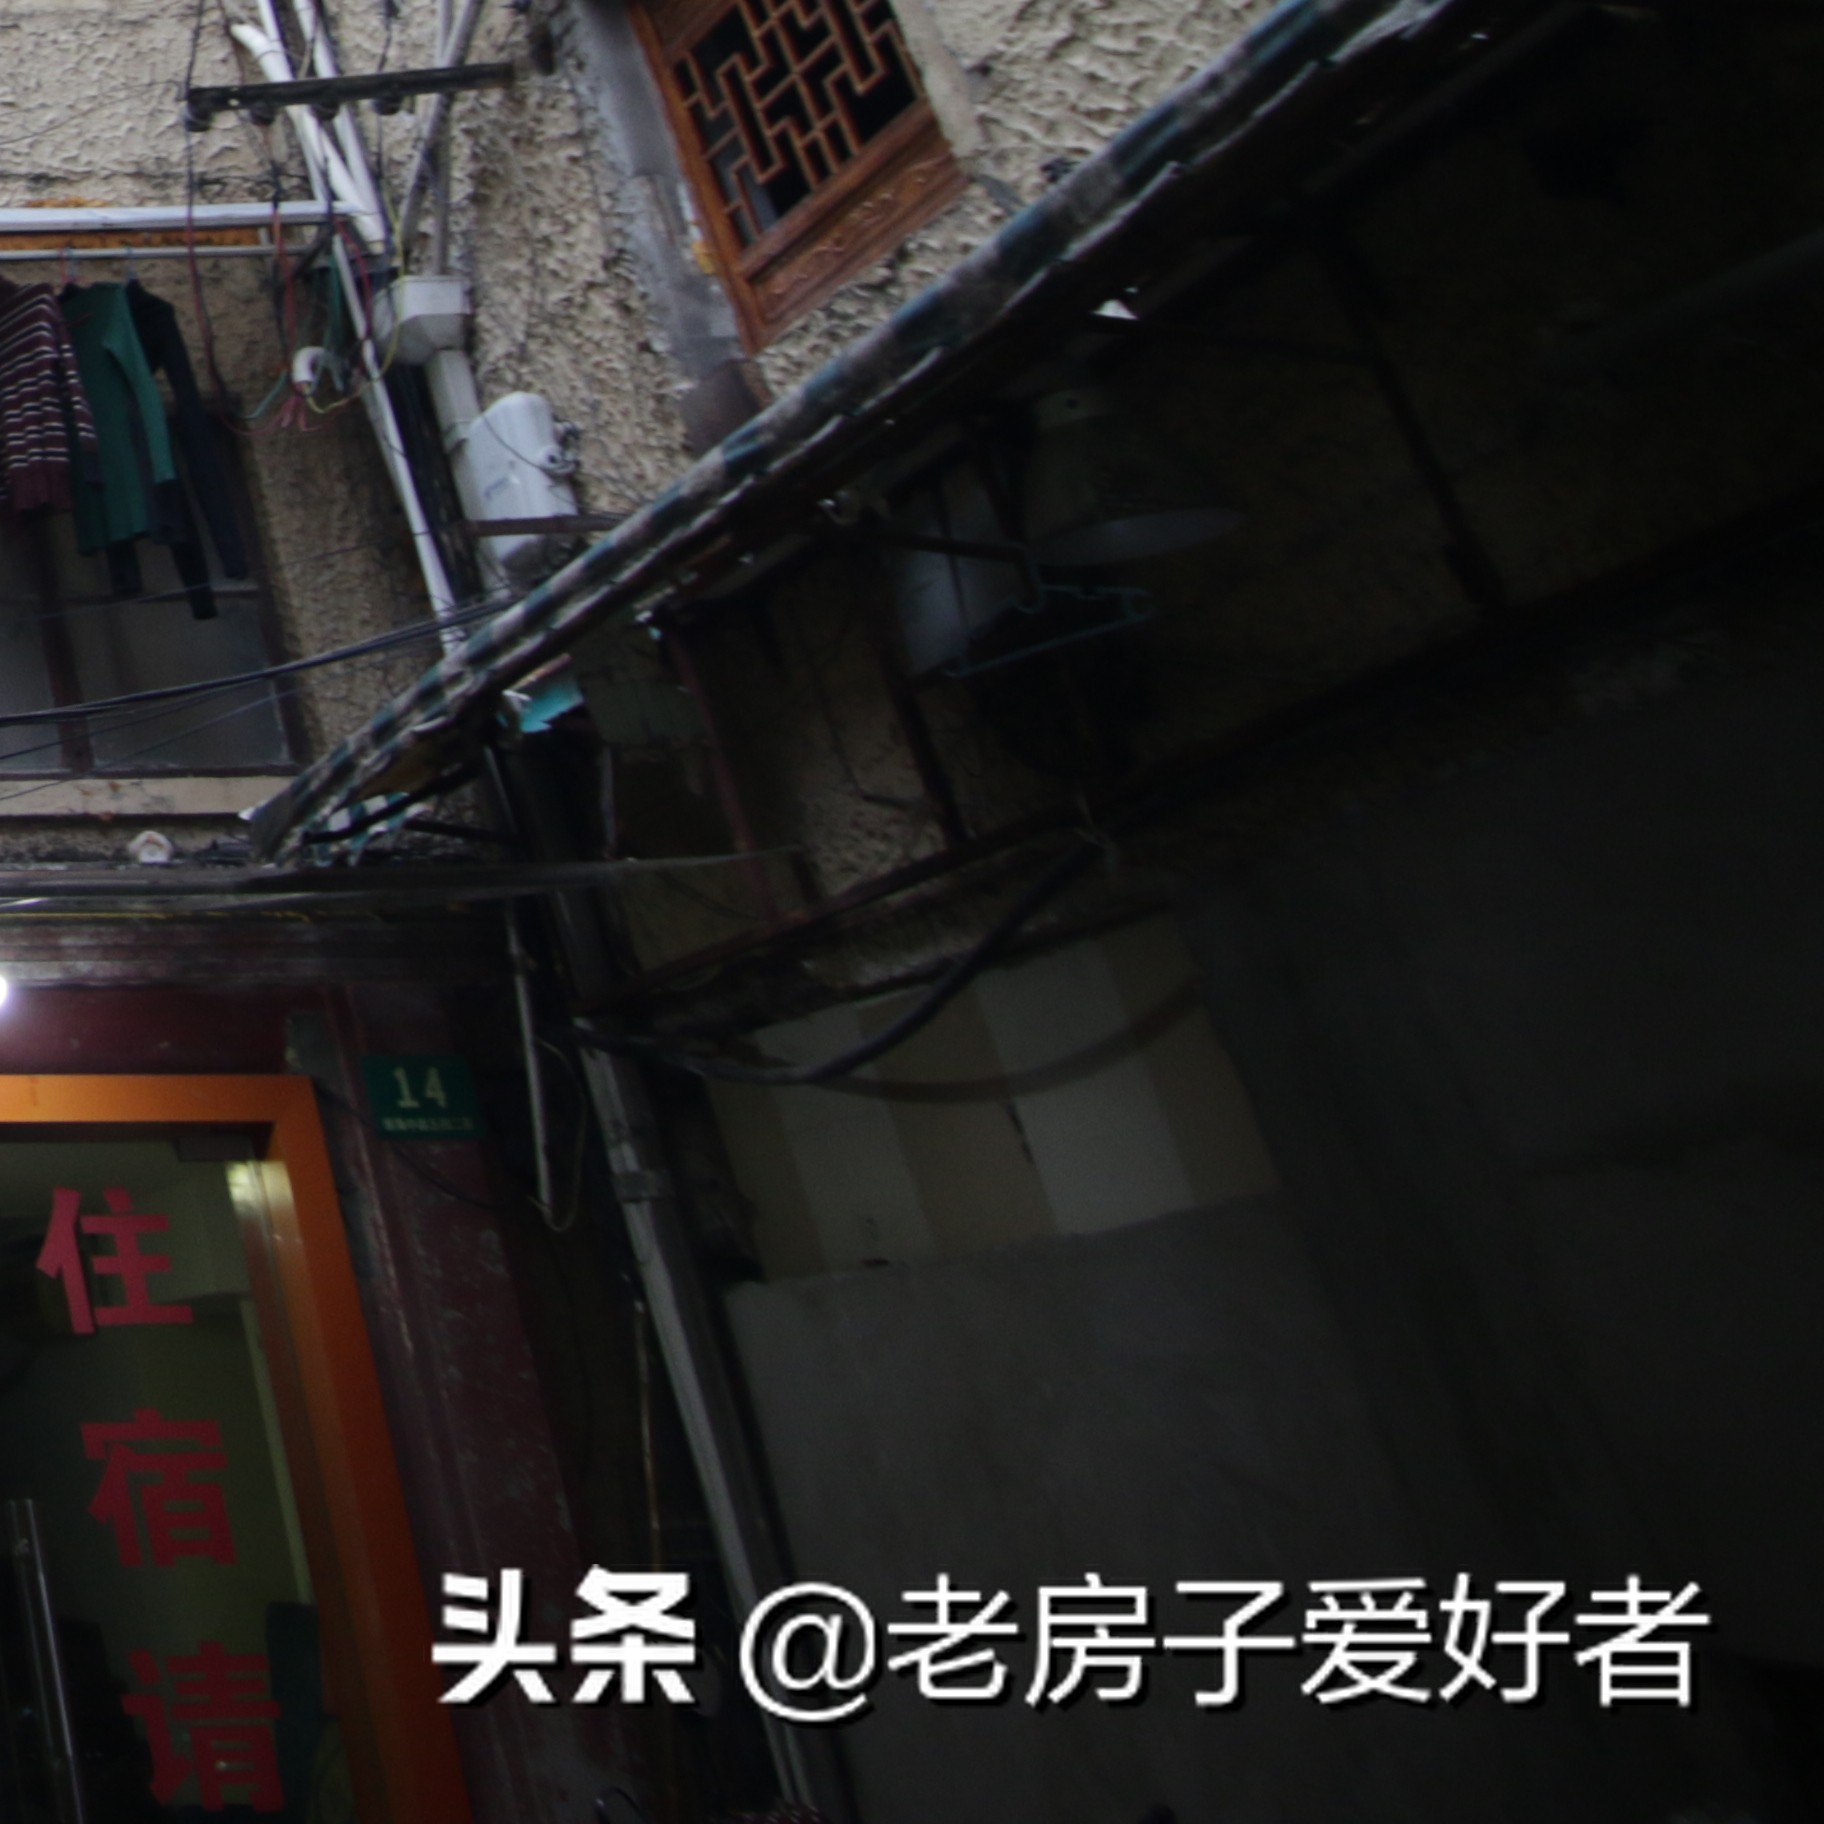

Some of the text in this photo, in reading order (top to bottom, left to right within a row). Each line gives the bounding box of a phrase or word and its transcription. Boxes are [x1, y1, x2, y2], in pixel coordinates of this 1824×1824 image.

[393, 1066, 449, 1109] 14
[35, 1185, 285, 1812] 住宿请
